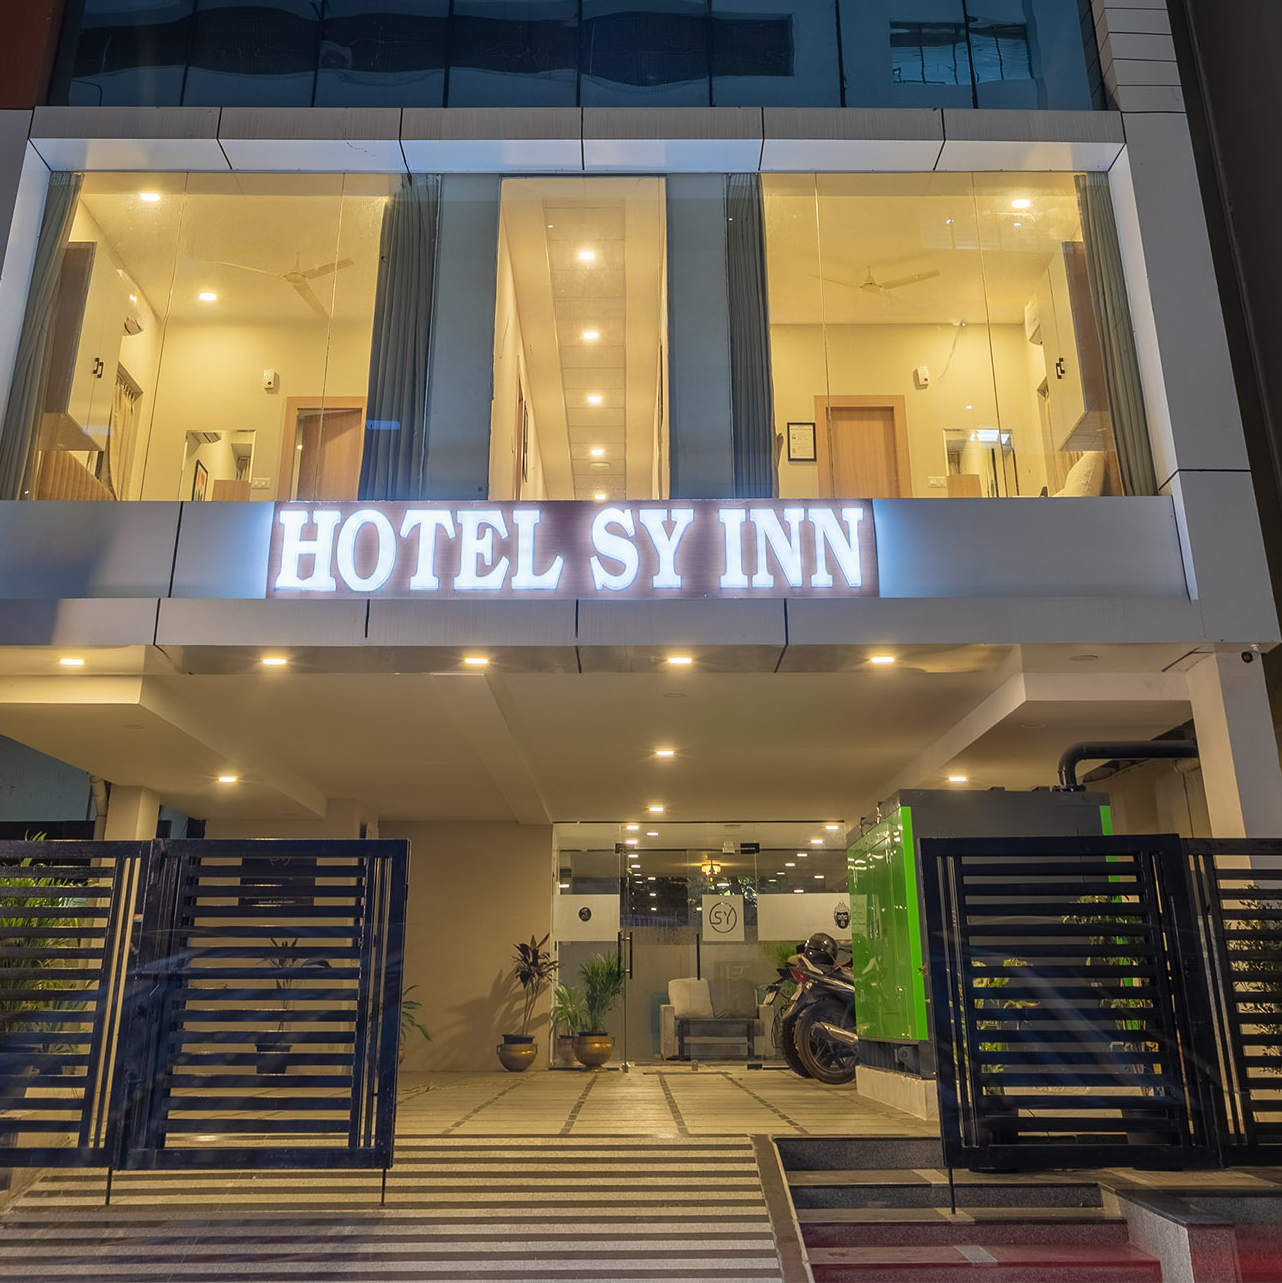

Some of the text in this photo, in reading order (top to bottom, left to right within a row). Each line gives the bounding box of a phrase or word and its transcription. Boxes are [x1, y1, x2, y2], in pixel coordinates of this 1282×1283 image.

[275, 507, 864, 591] HOTEL SY INN
[711, 907, 734, 925] SY
